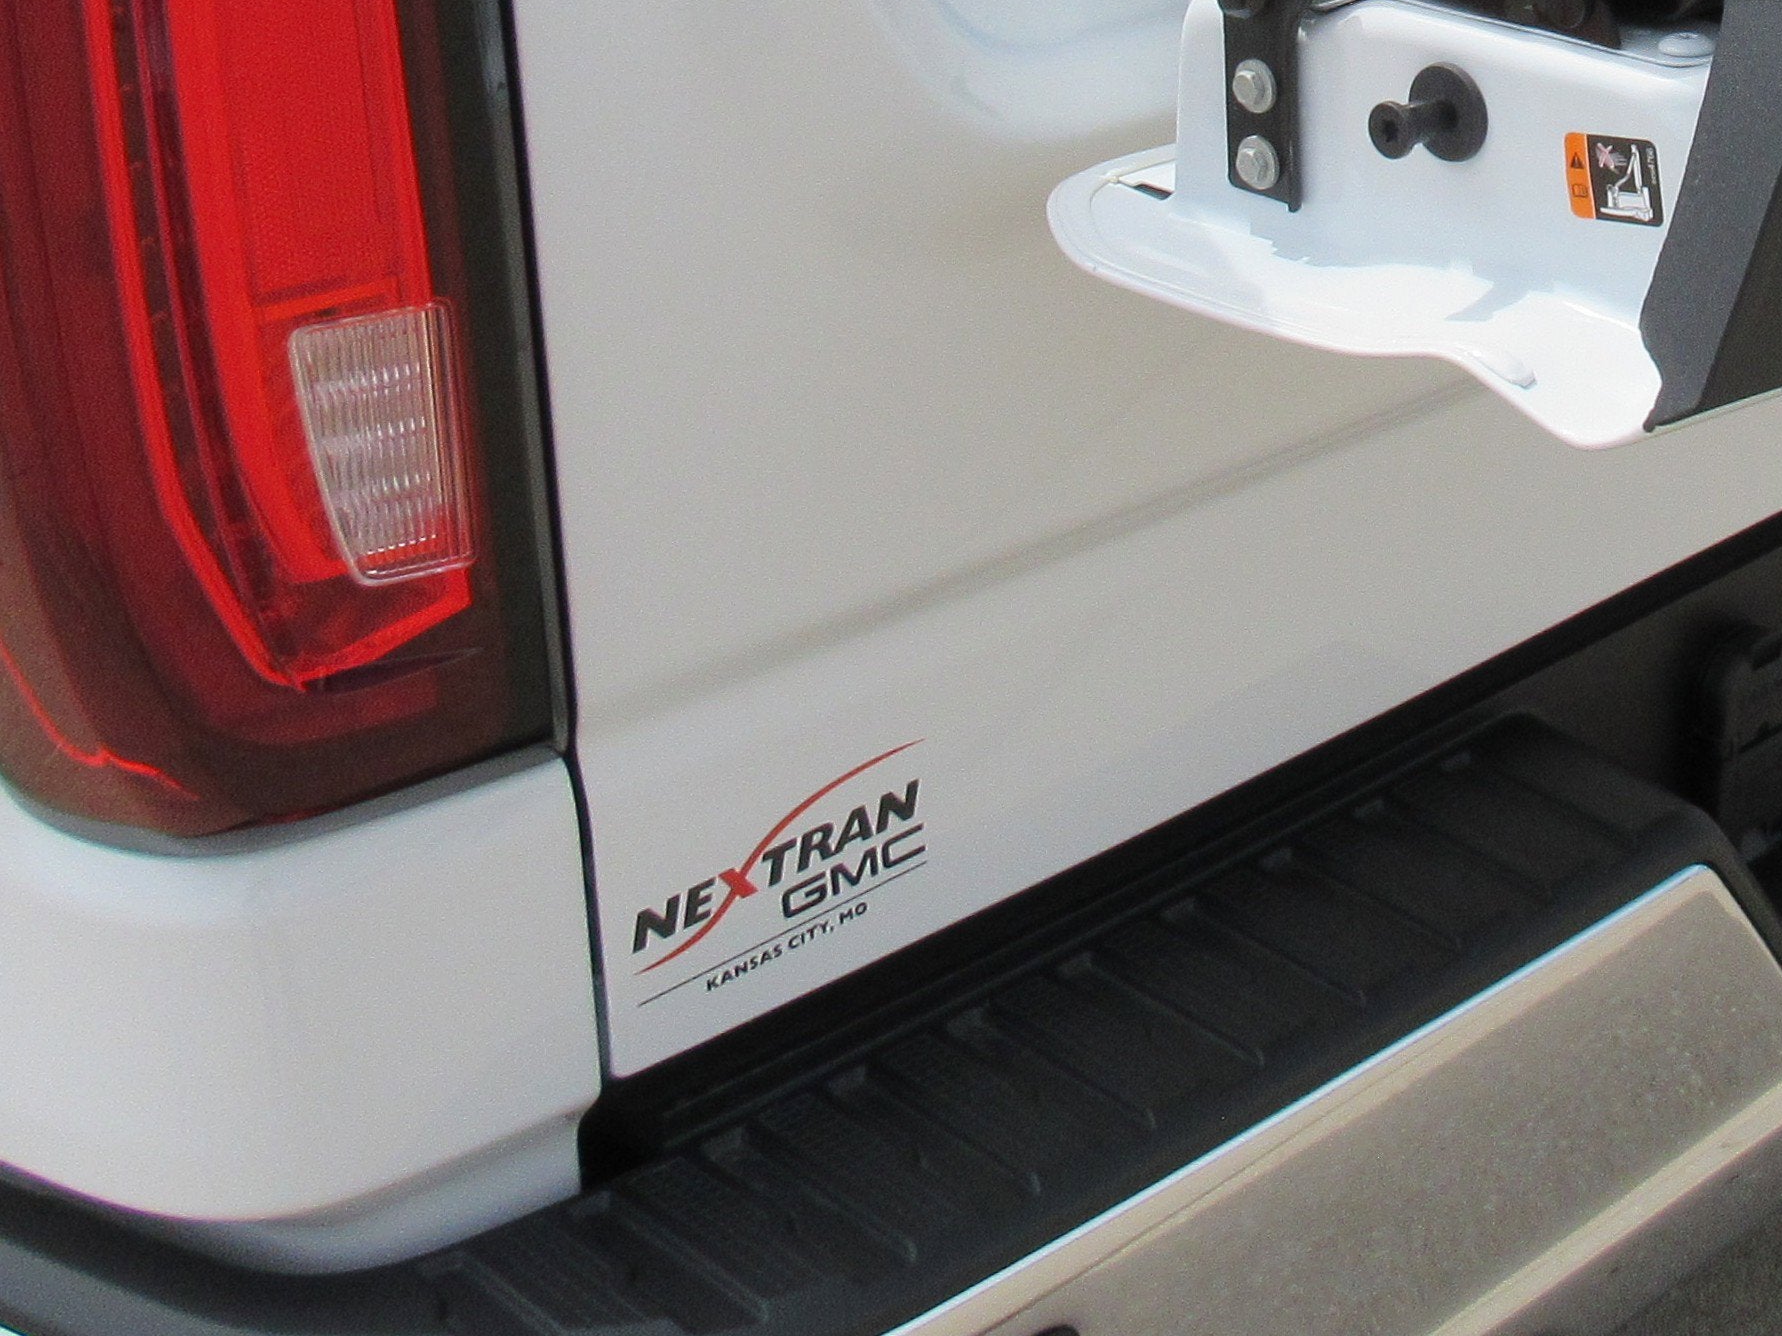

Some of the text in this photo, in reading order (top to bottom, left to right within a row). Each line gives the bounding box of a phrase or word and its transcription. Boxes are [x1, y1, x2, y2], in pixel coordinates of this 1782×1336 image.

[632, 778, 921, 954] NEXTRAN
[781, 822, 927, 919] GMC
[705, 901, 868, 992] KANSAS CITY, MO
